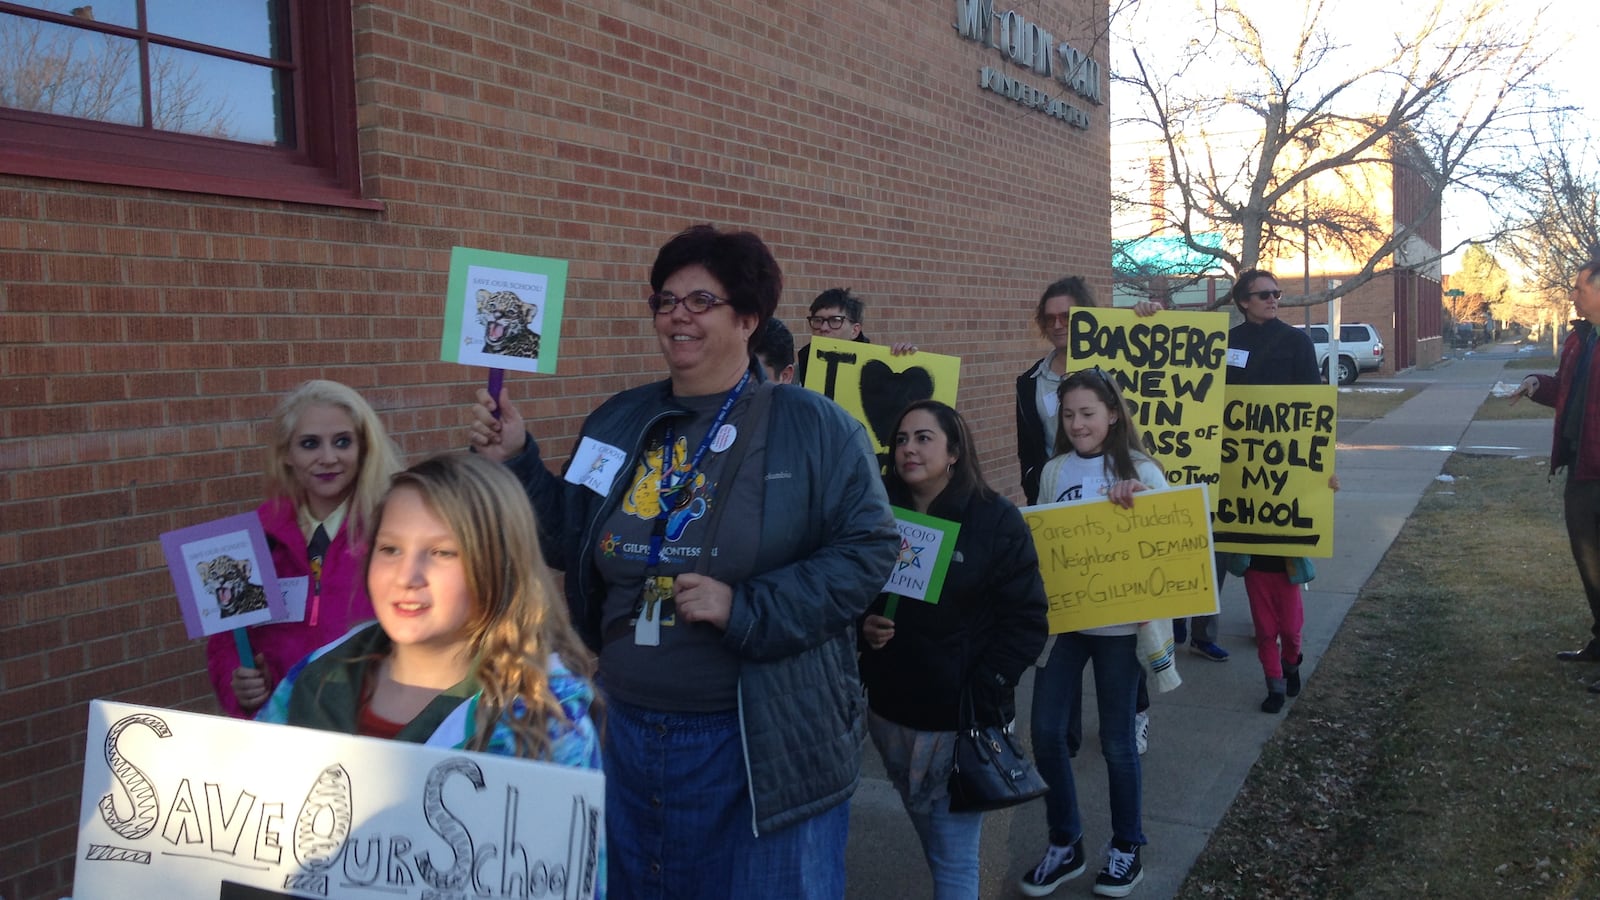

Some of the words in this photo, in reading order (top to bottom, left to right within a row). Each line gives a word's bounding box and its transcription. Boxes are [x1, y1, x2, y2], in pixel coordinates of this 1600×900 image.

[1070, 310, 1226, 370] BOASBERG
[1109, 368, 1213, 403] NEW
[1223, 400, 1334, 433] CHARTER
[1221, 435, 1330, 472] STOLE
[898, 524, 936, 543] SCOJO
[1113, 504, 1193, 534] Students,
[1051, 544, 1129, 576] Neighbors
[1138, 534, 1209, 560] DEMAND
[891, 573, 924, 591] LPIN
[1048, 591, 1087, 612] EEP
[1087, 573, 1148, 604] GILPIN
[99, 713, 284, 865] SAVE
[294, 762, 416, 887] OUR
